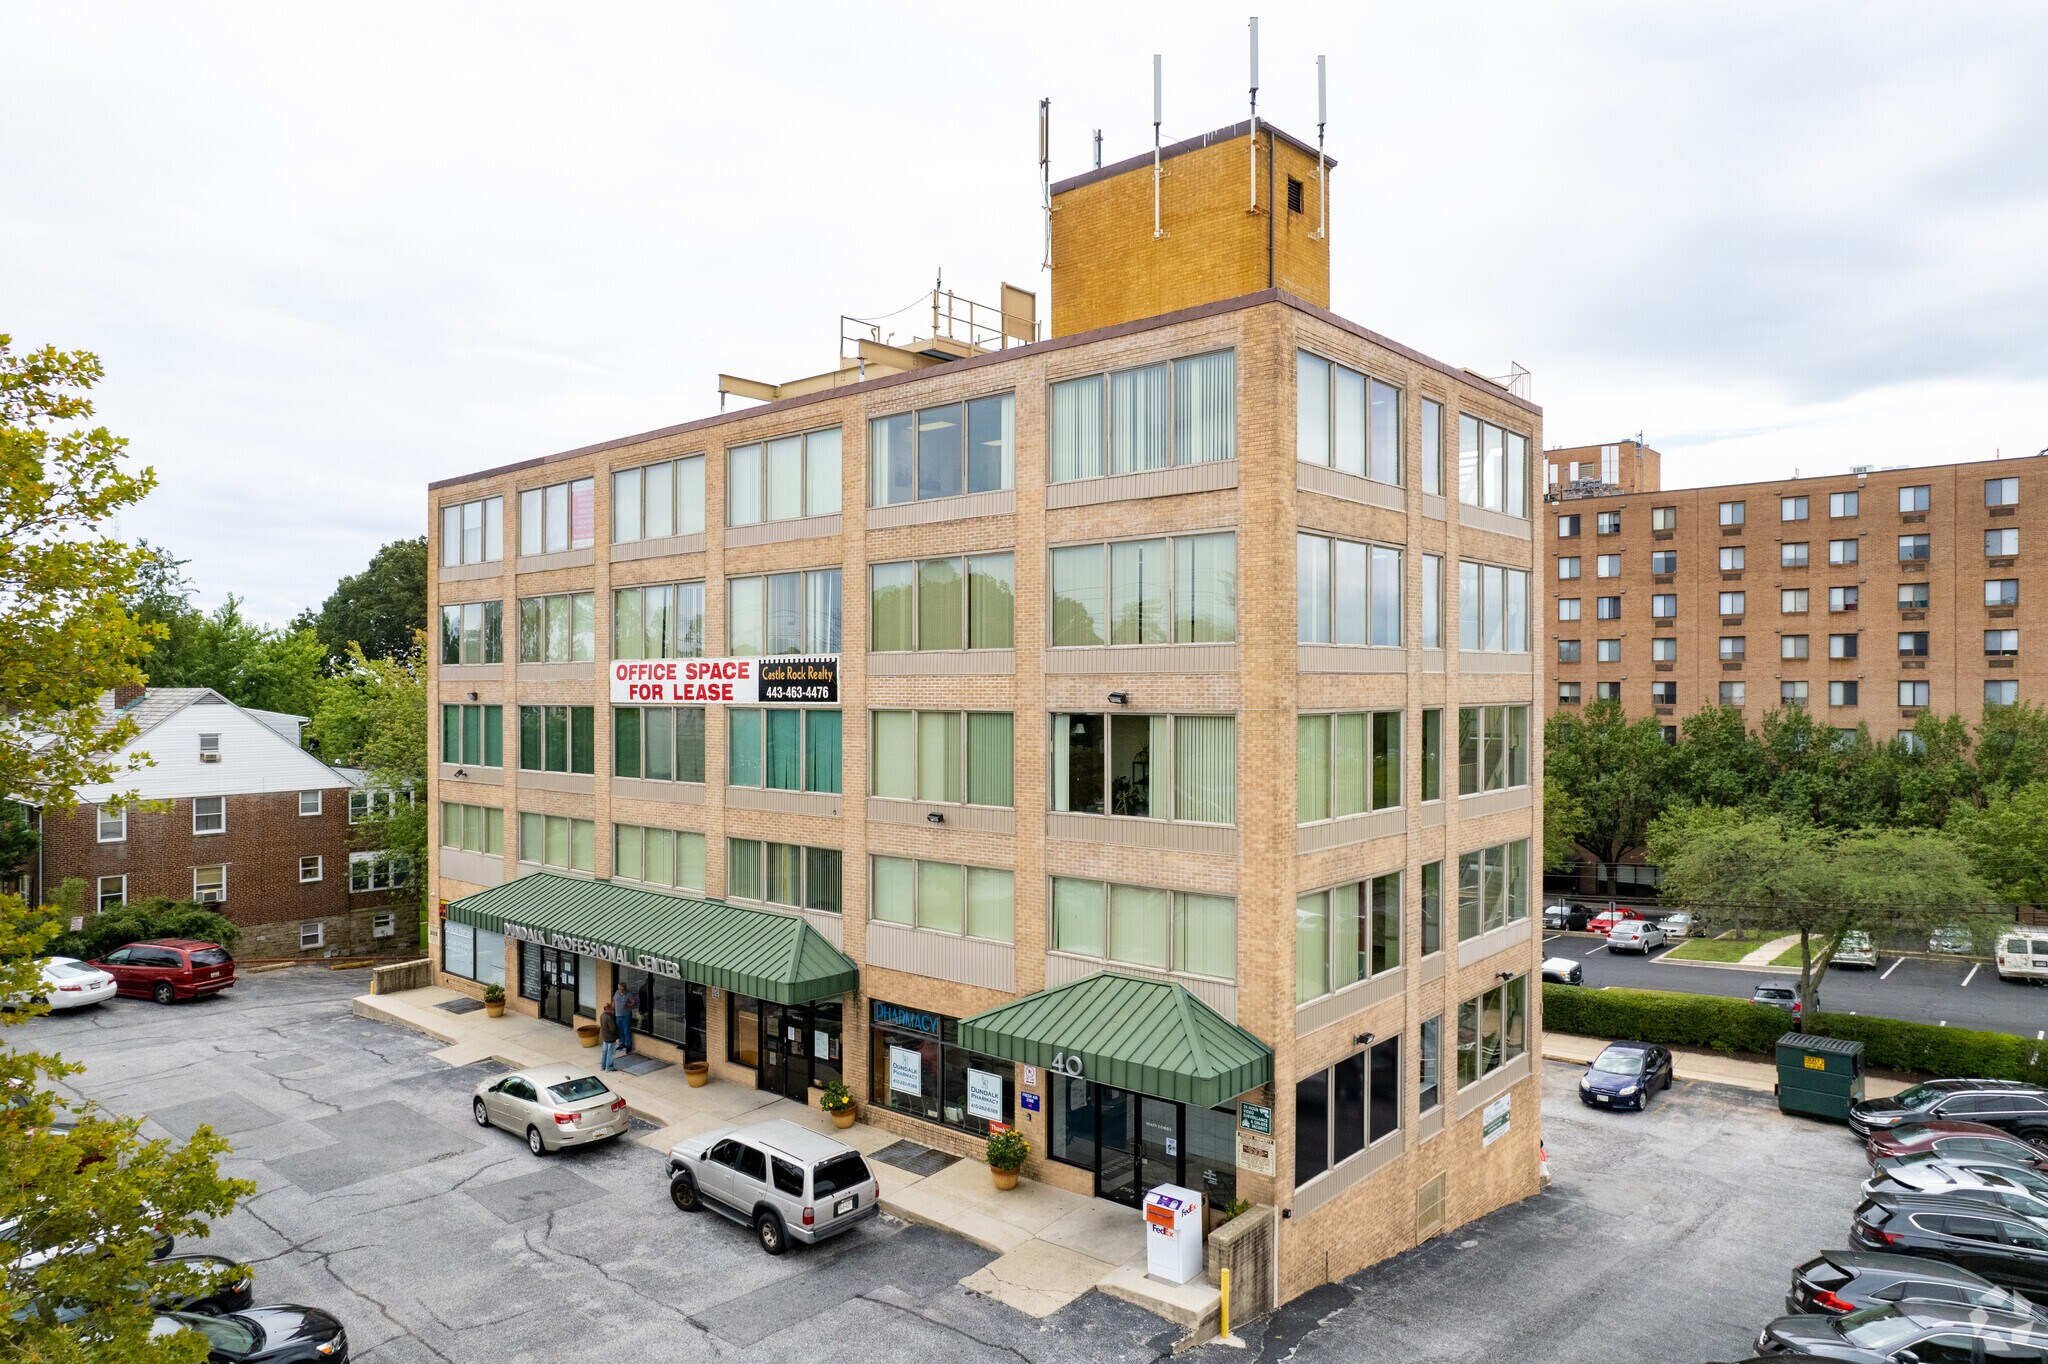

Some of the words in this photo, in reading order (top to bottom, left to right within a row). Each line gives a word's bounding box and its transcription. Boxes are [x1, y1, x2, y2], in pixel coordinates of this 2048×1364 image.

[616, 663, 677, 681] OFFICE
[685, 662, 750, 680] SPACE
[762, 666, 785, 681] Castle
[787, 667, 806, 680] Rock
[808, 666, 833, 683] Realty
[629, 684, 663, 701] FOR
[673, 683, 734, 701] LEASE
[766, 686, 829, 699] 443-463-4476
[503, 922, 546, 944] DUNDALK
[551, 933, 631, 965] PROFESSIONAL
[637, 954, 681, 979] CENTER
[874, 1001, 939, 1033] PHARMACY
[1051, 1052, 1083, 1076] 40
[1157, 1124, 1172, 1132] LOBBY
[1181, 1203, 1197, 1217] FedEx
[1152, 1223, 1174, 1238] FedEx
